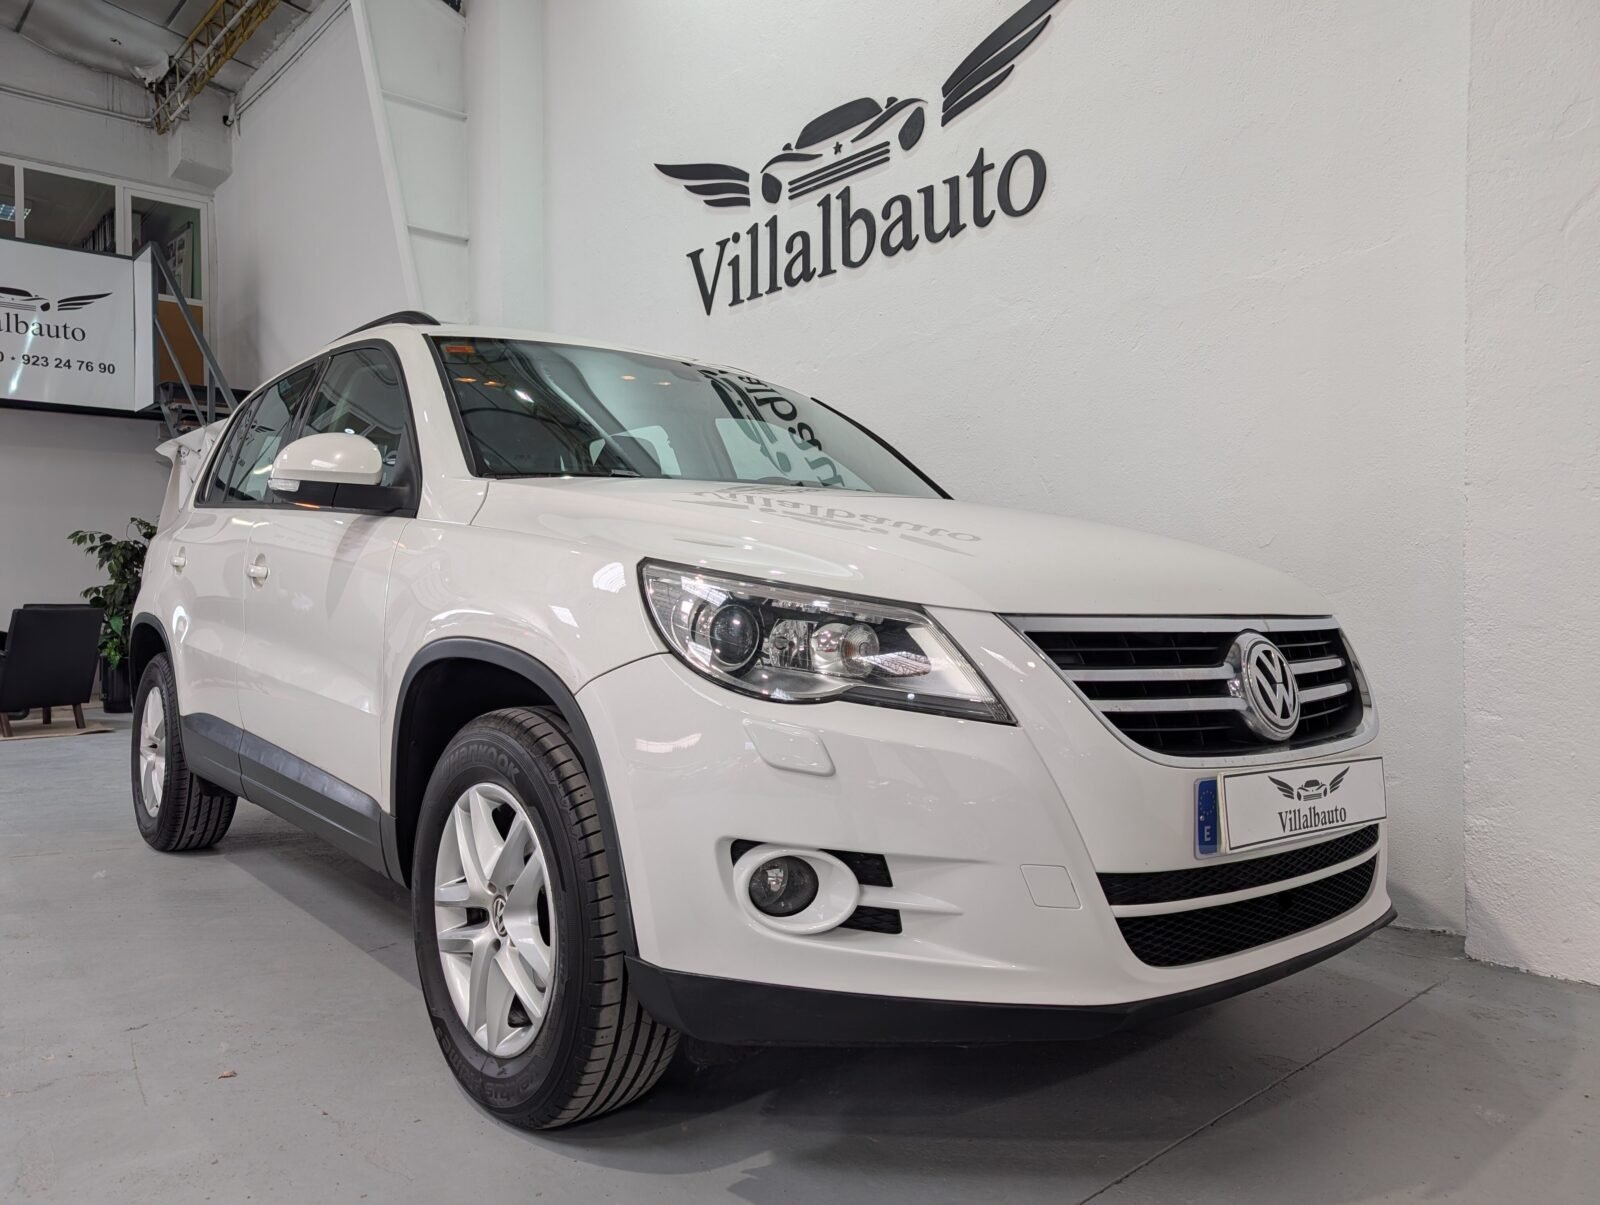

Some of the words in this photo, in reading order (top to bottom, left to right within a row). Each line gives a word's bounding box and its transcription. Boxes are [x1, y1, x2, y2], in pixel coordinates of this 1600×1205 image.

[686, 147, 1048, 316] Villalbauto
[22, 353, 49, 367] 923
[54, 357, 72, 369] 24
[77, 359, 94, 372] 76
[98, 362, 116, 375] 90
[1278, 805, 1347, 833] Villalbauto
[1204, 825, 1211, 842] E
